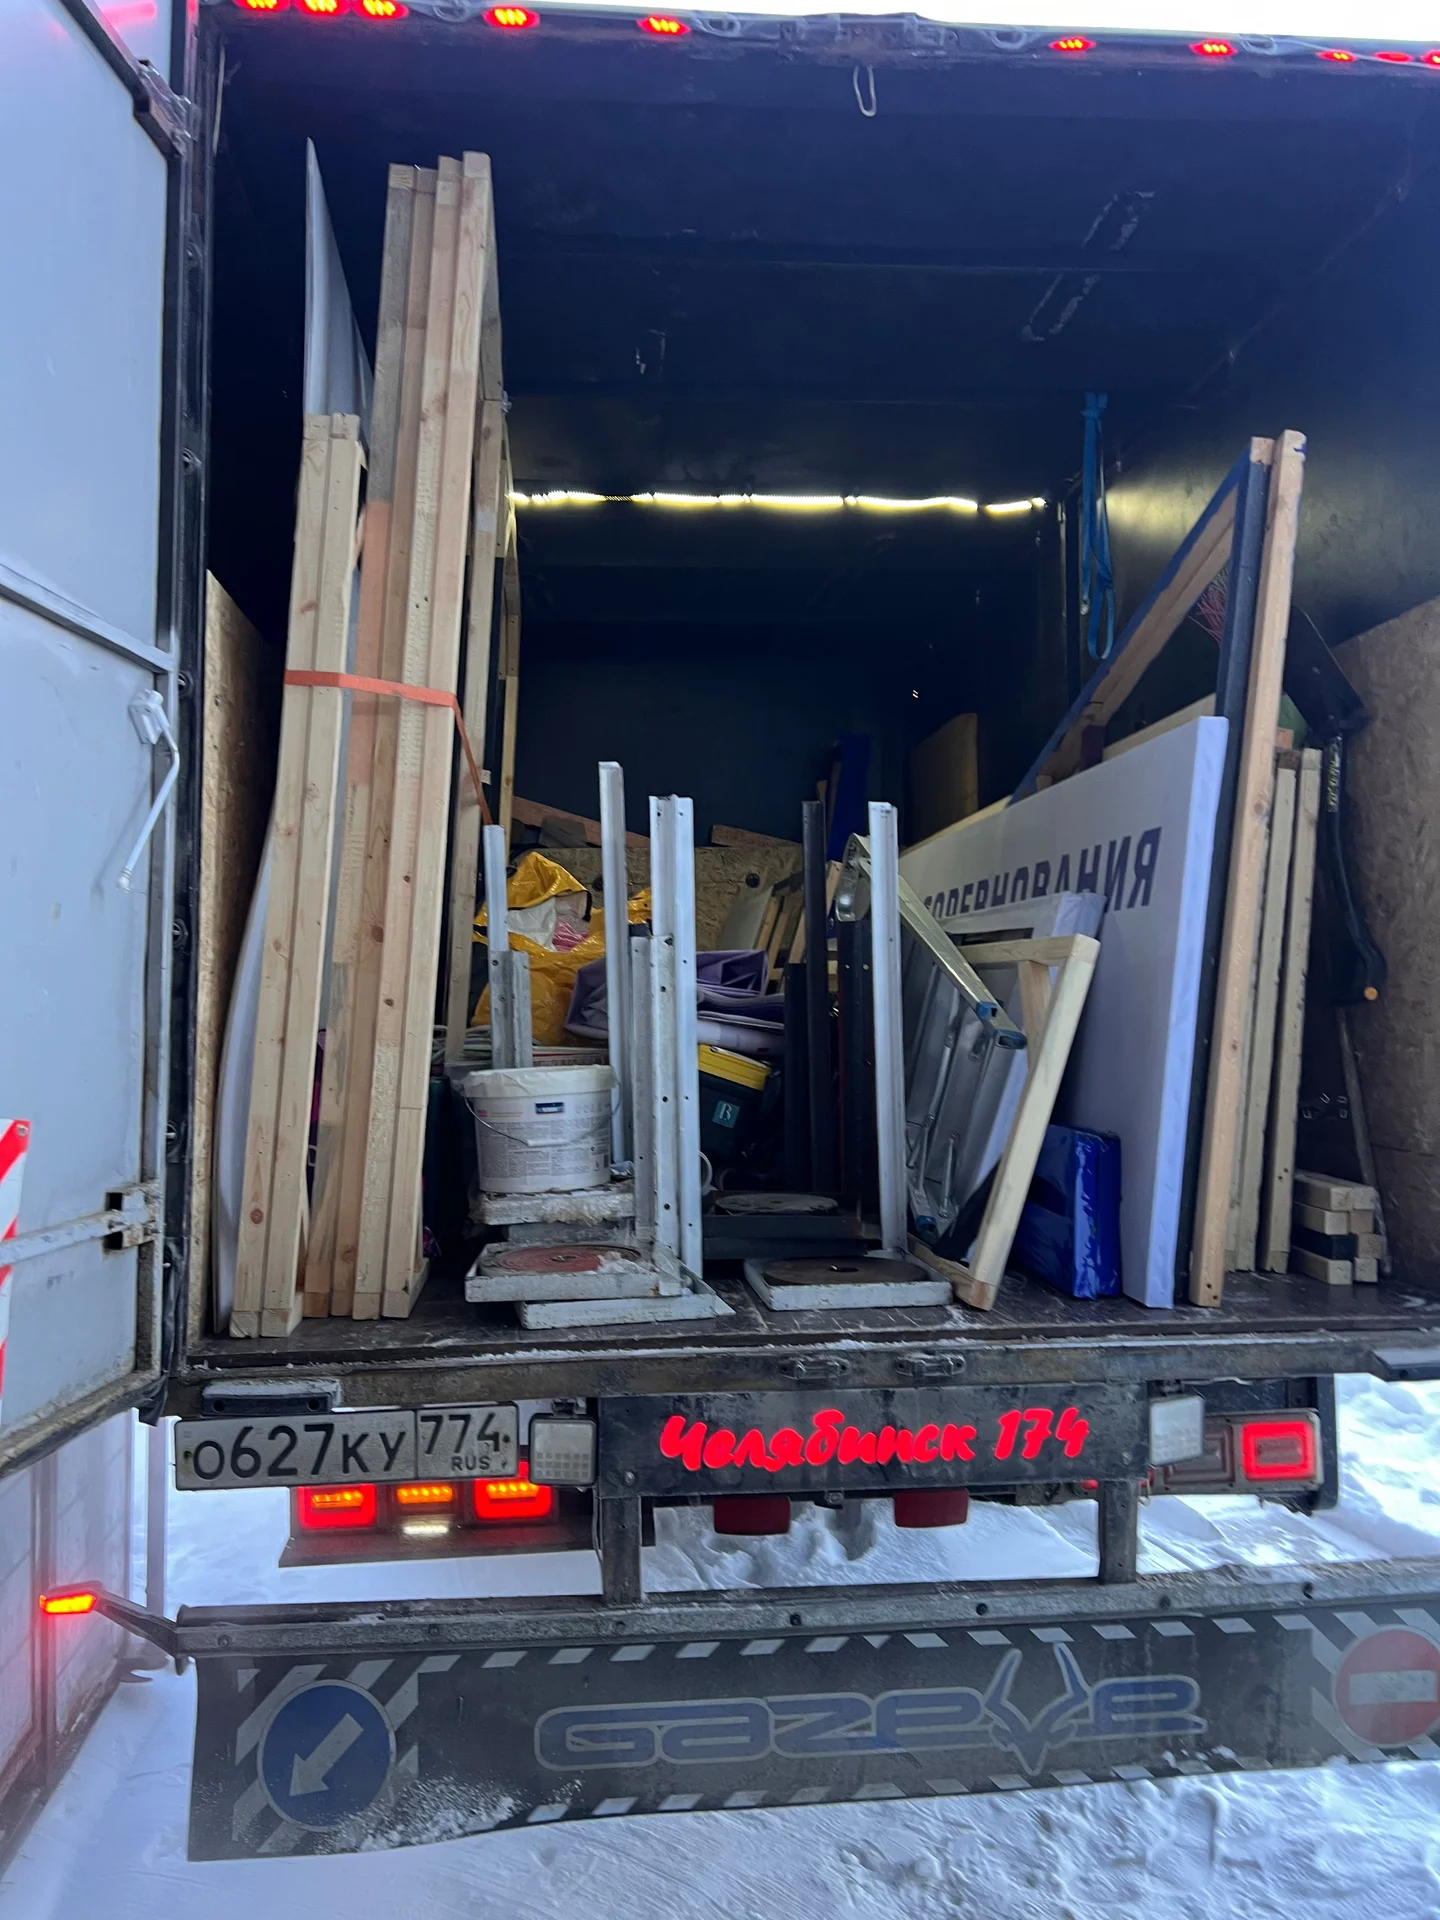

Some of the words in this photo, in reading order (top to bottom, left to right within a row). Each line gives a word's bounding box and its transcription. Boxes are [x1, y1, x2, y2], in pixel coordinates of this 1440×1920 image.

[193, 1422, 406, 1480] О627КУ
[420, 1412, 500, 1455] 774
[451, 1455, 490, 1472] RUS
[660, 1409, 976, 1471] Челябинск
[994, 1407, 1089, 1460] 174
